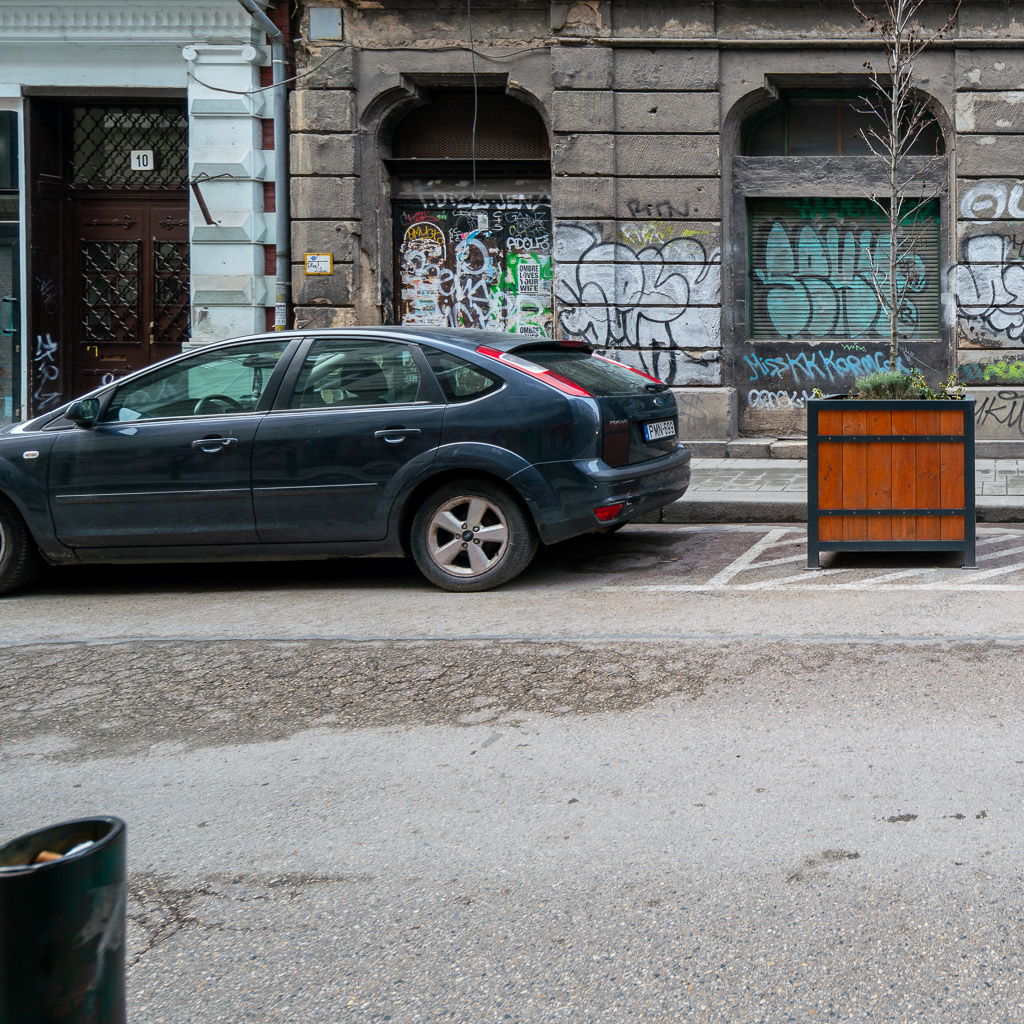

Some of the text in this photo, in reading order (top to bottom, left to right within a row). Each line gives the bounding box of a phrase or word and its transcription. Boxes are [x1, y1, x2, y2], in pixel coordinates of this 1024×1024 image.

[136, 154, 149, 168] 10
[519, 264, 539, 272] OMBRE
[648, 420, 675, 439] PMN-699
